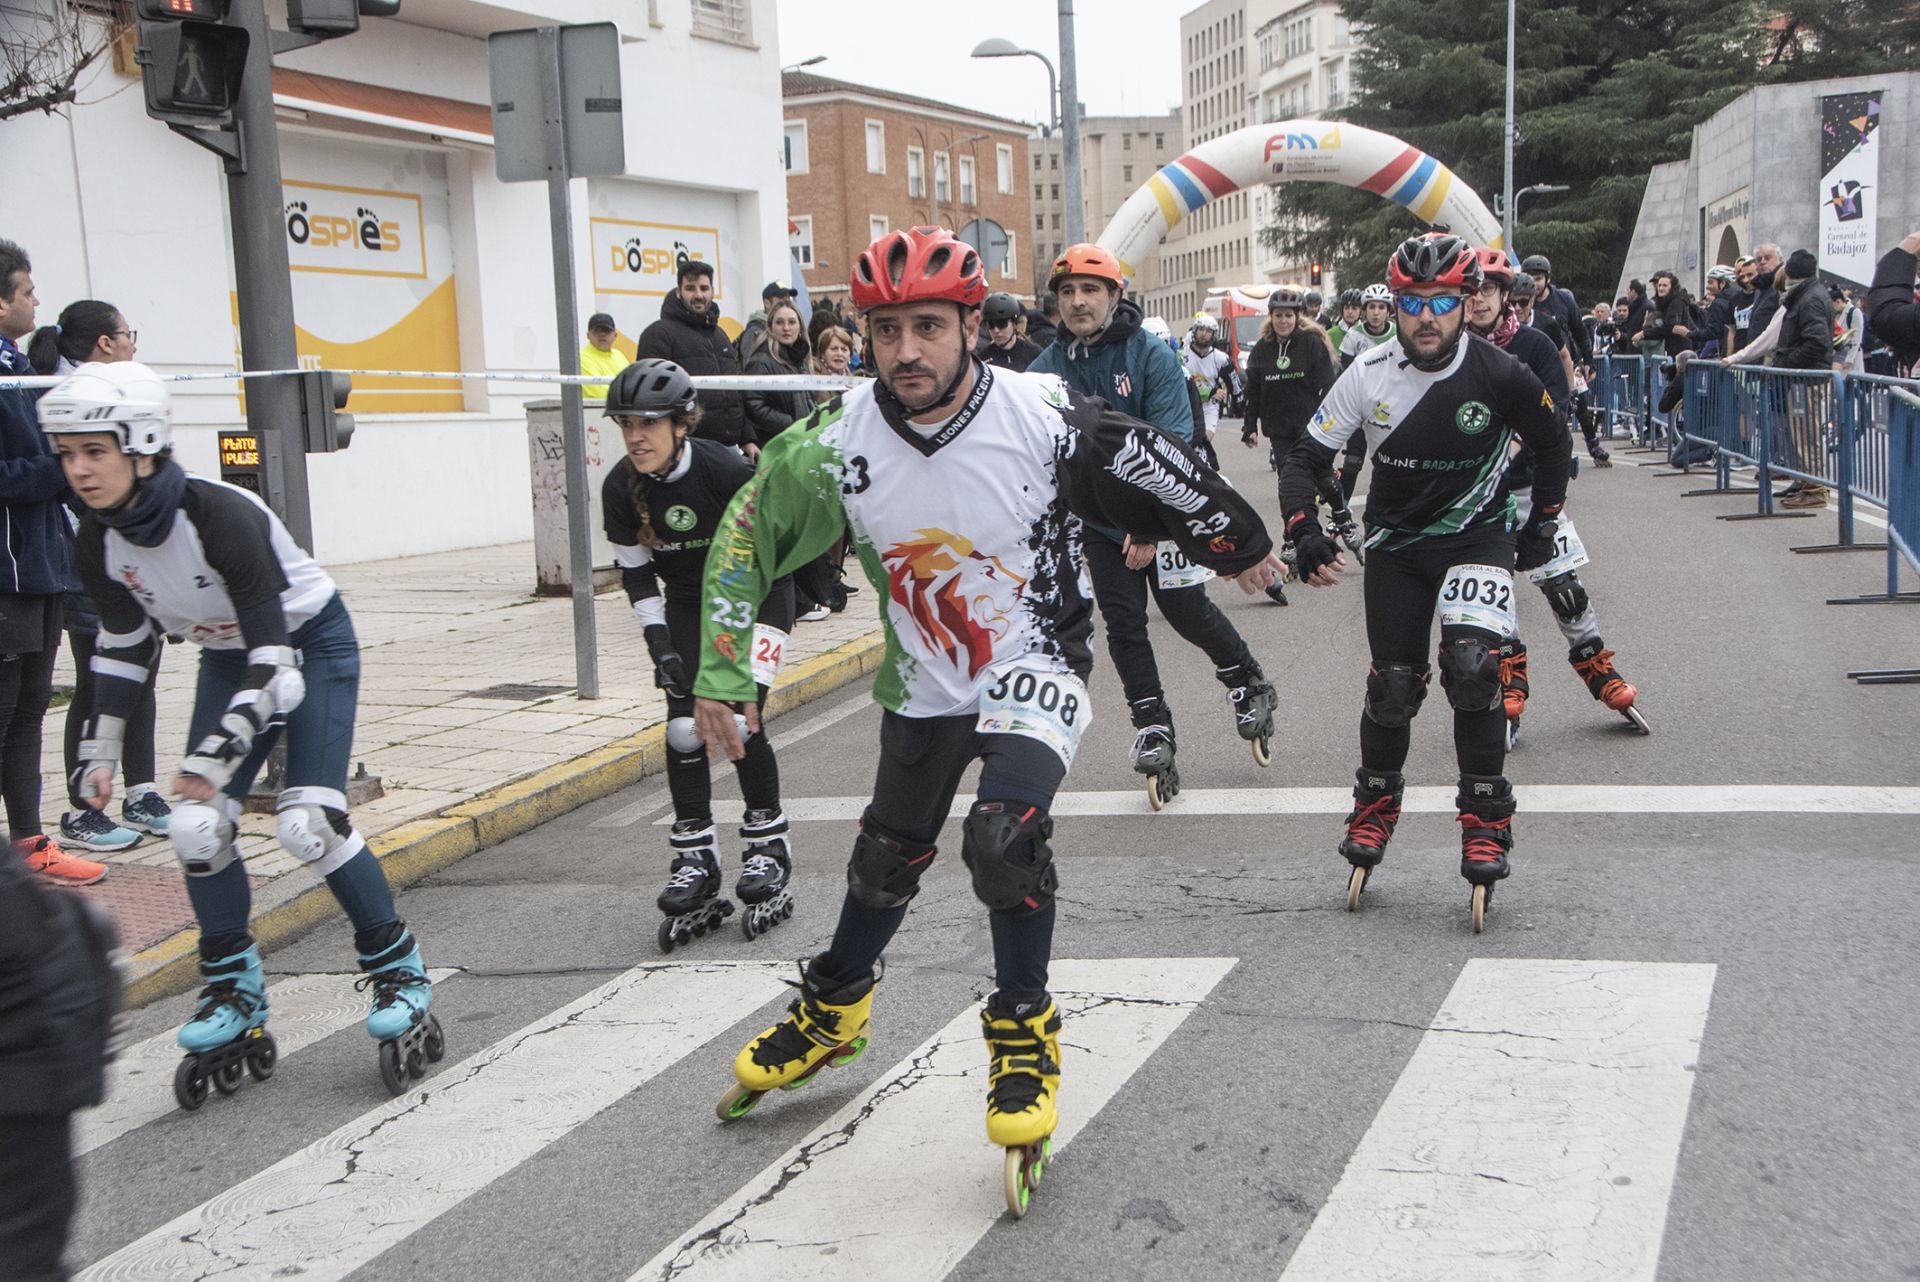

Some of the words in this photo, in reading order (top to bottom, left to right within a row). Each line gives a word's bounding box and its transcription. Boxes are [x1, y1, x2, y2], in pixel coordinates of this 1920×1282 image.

[1827, 241, 1866, 257] Badajoz
[936, 410, 971, 445] LEONES
[1378, 451, 1418, 469] INLINE
[1186, 511, 1230, 537] 23
[1443, 577, 1510, 612] 3032
[711, 597, 752, 629] 23
[988, 671, 1078, 727] 3008
